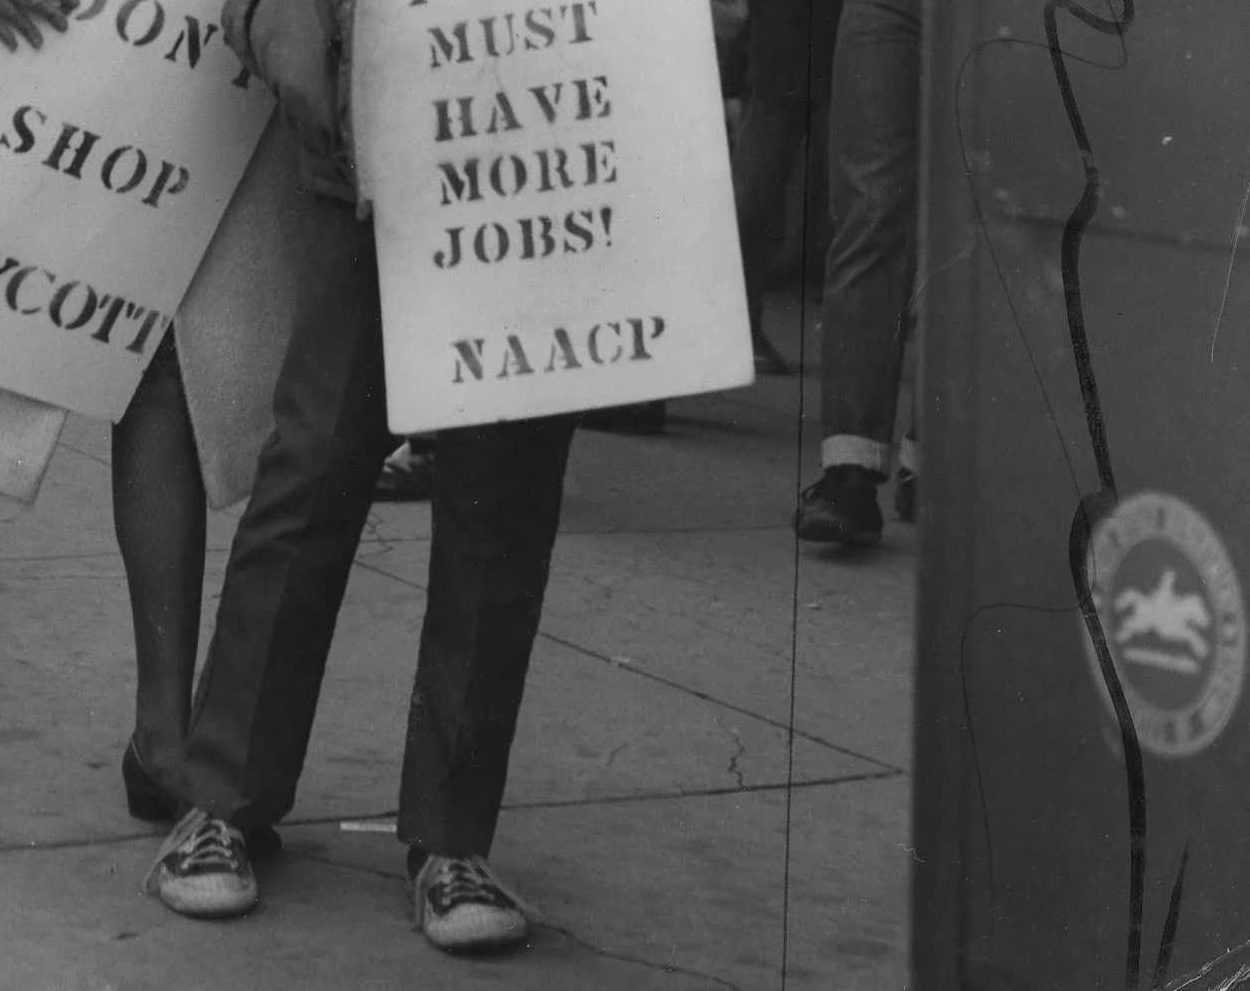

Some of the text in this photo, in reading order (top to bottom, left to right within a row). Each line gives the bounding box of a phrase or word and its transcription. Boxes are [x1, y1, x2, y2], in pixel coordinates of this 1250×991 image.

[429, 1, 598, 68] MUST
[432, 75, 612, 142] HAVE
[437, 140, 618, 205] MORE
[433, 206, 614, 269] JOBS!
[451, 315, 666, 384] NAACP
